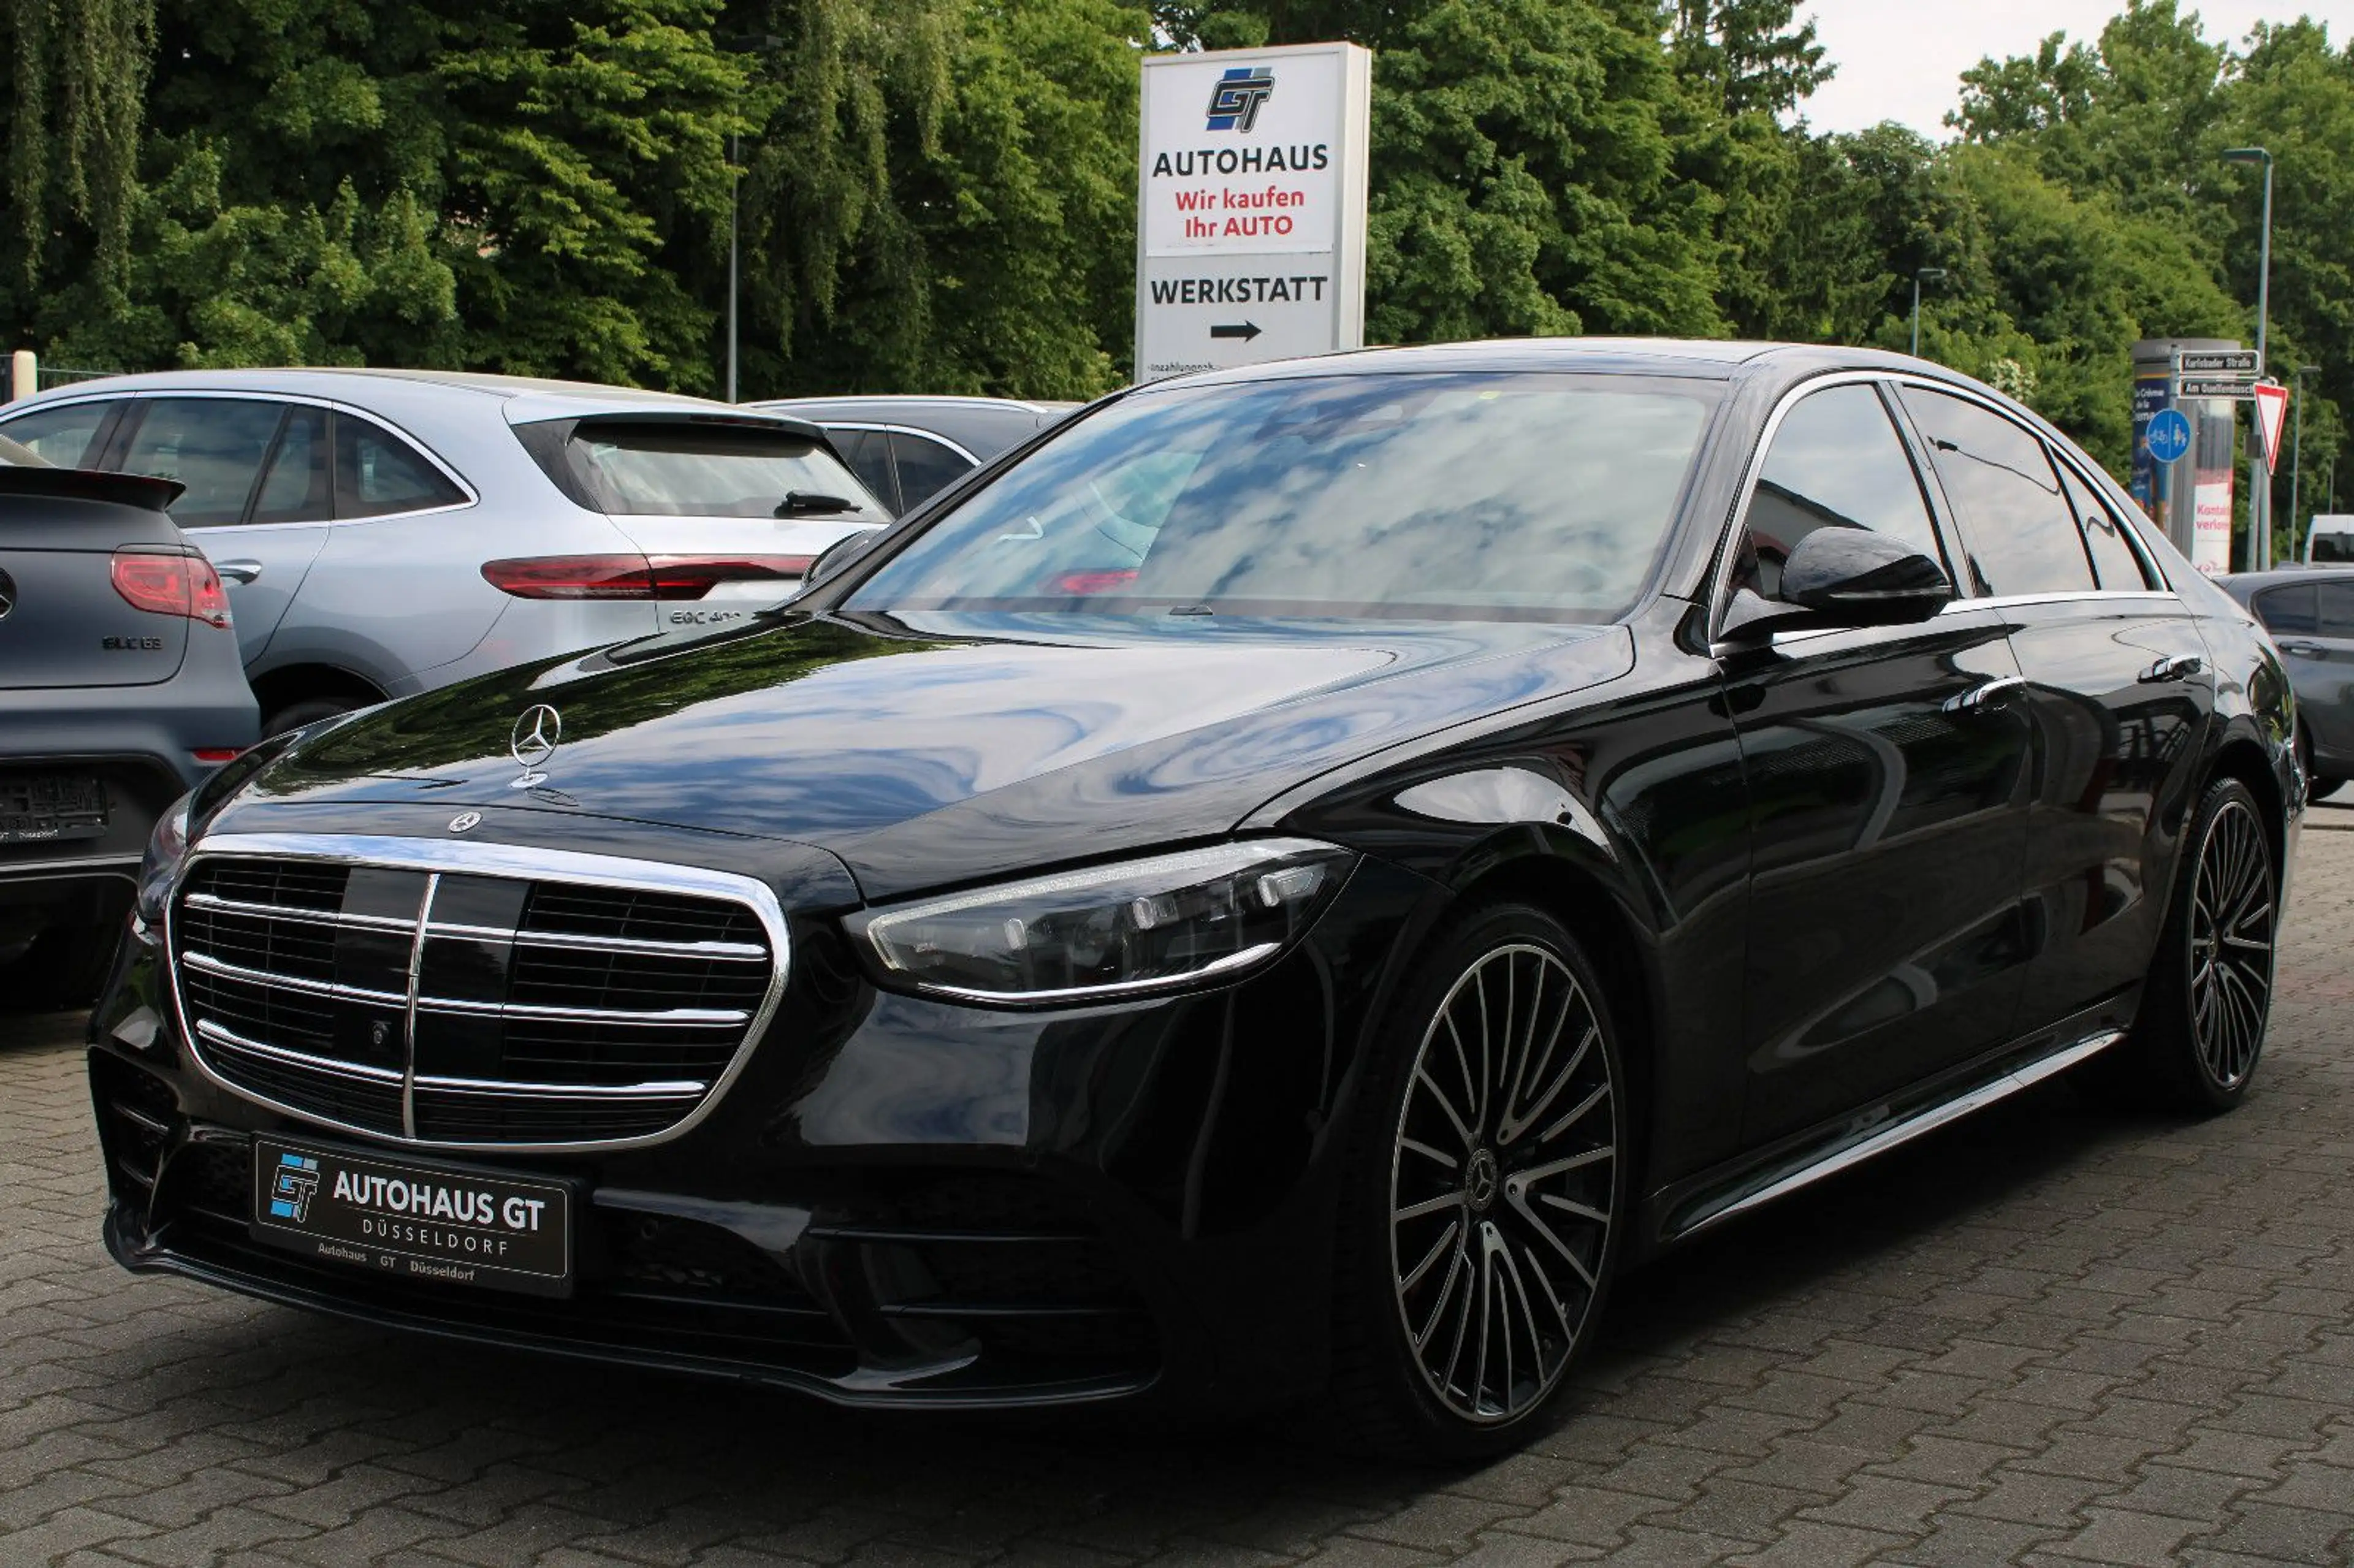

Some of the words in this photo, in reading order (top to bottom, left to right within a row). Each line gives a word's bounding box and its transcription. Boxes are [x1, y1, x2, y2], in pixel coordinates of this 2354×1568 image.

[1152, 144, 1328, 177] AUTOHAUS
[1175, 190, 1216, 211] Wir
[1223, 186, 1305, 210] kaufen
[1185, 217, 1217, 238] Ihr
[1223, 216, 1293, 237] AUTO
[1151, 276, 1328, 304] WERKSTATT
[2226, 357, 2251, 368] Straße
[2186, 382, 2199, 393] Am
[671, 610, 706, 625] EQC
[333, 1171, 494, 1224] AUTOHAUS
[503, 1197, 545, 1231] GT
[362, 1219, 508, 1256] DÜSSELDORF
[318, 1242, 367, 1262] Autohaus
[379, 1255, 396, 1269] GT
[409, 1260, 476, 1282] Düsseldorf
